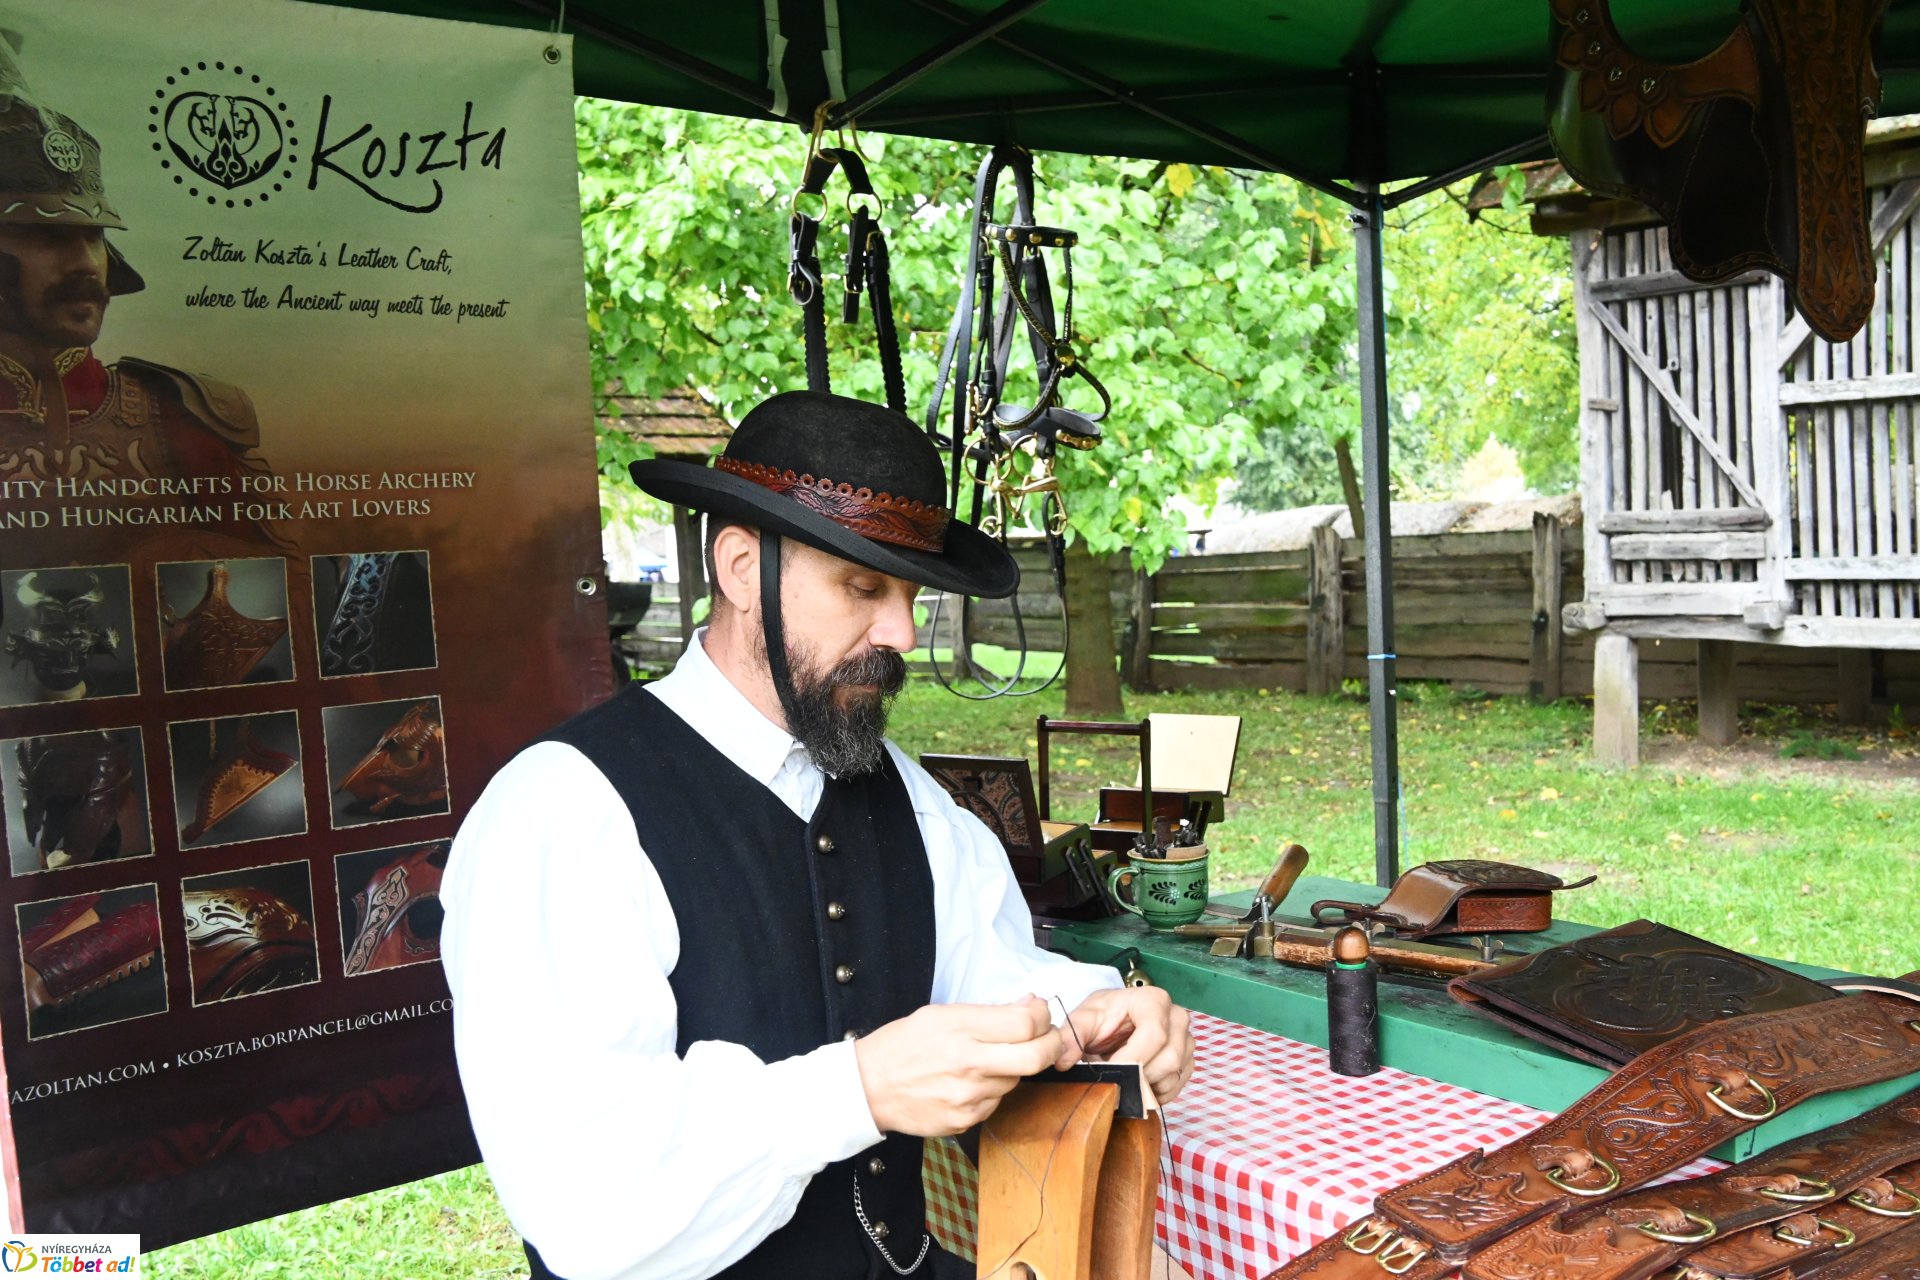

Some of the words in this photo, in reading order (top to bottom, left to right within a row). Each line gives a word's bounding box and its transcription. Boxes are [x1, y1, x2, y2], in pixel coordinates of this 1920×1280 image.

[307, 94, 508, 214] Koszta
[254, 239, 327, 267] Koszta's
[337, 242, 399, 269] Leather
[405, 246, 453, 275] Craft,
[185, 285, 237, 307] where
[241, 286, 270, 309] the
[276, 284, 347, 311] Ancient
[349, 298, 380, 319] way
[387, 294, 425, 315] meets
[430, 294, 453, 316] the
[456, 299, 511, 324] present
[0, 480, 48, 499] ITY
[56, 476, 232, 498] HANDCRAFTS
[241, 475, 289, 493] FOR
[296, 472, 372, 492] HORSE
[377, 471, 477, 490] ARCHERY
[61, 505, 222, 528] HUNGARIAN
[233, 501, 293, 521] FOLK
[299, 500, 344, 519] ART
[351, 498, 432, 517] LOVERS
[8, 1060, 156, 1105] AZOLTAN.COM
[176, 998, 454, 1068] KOSZTA.BORPANCEL@GMAIL.CO
